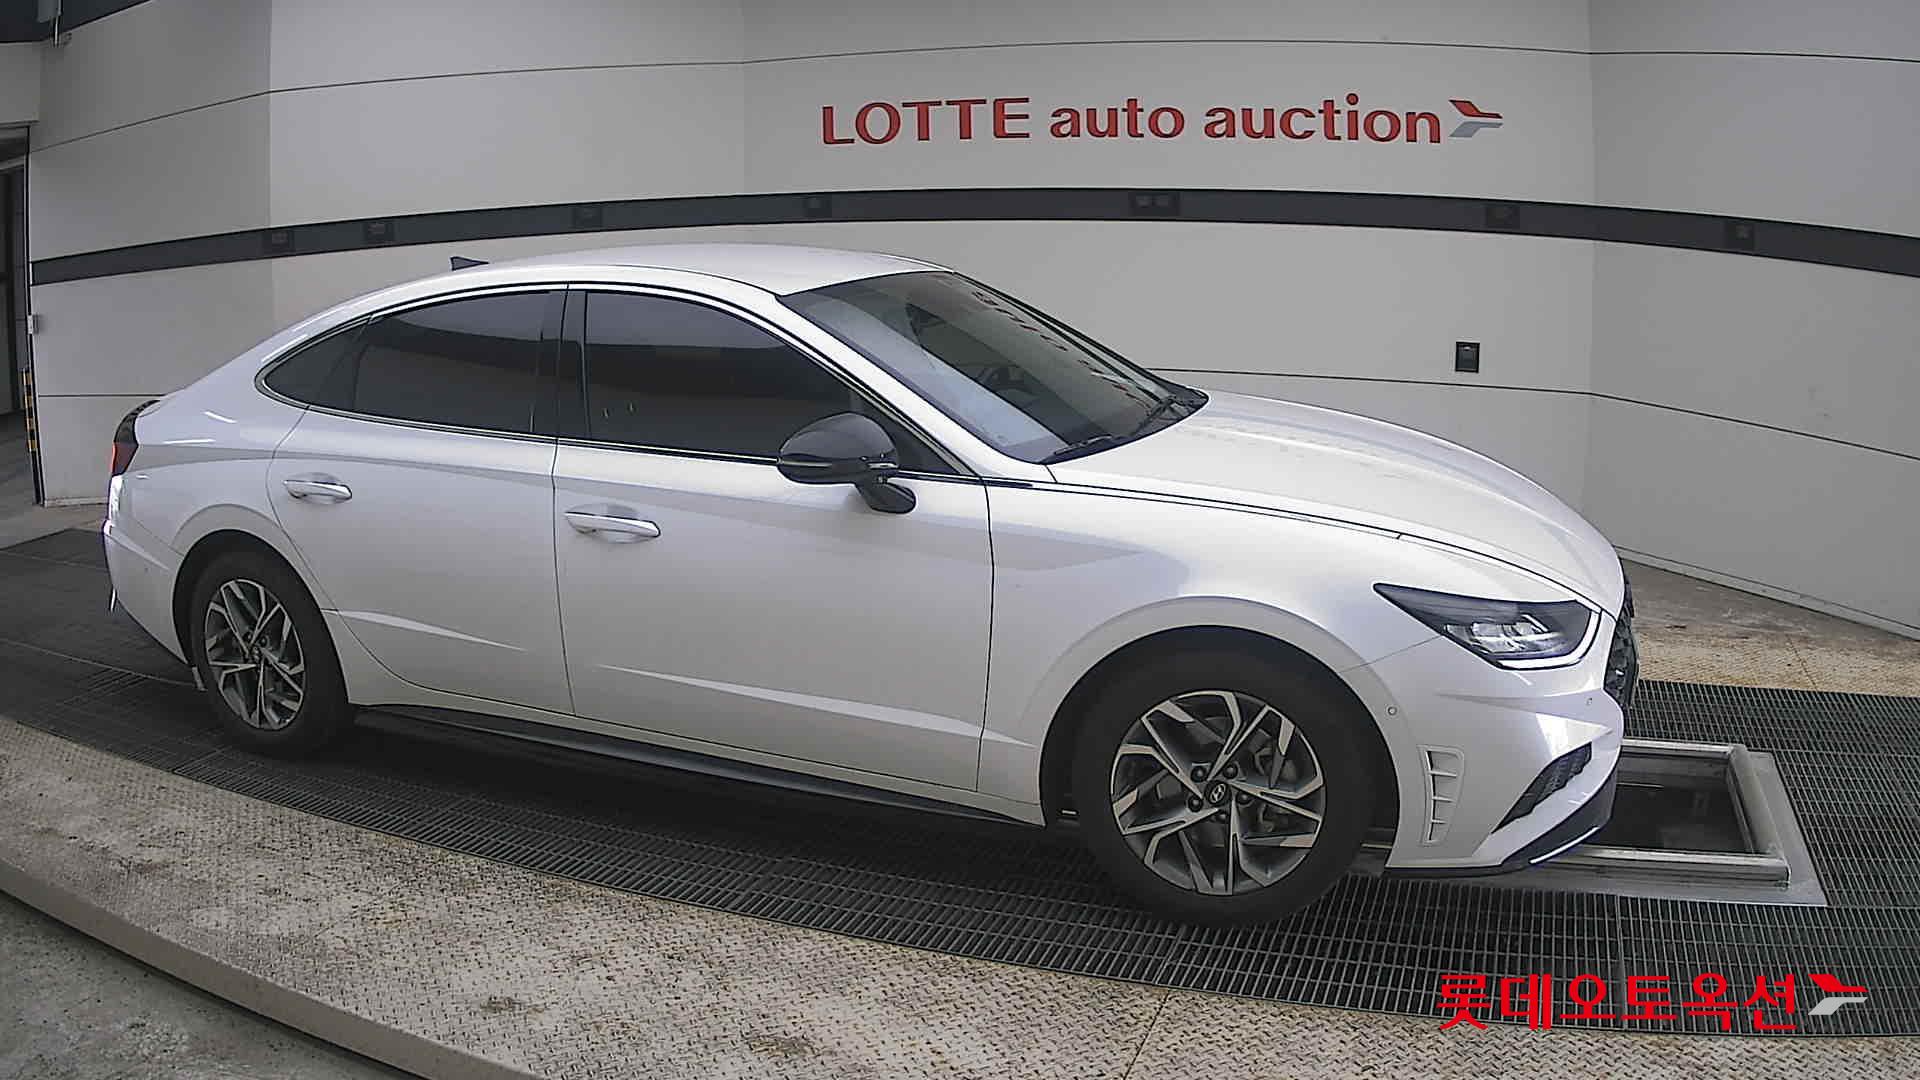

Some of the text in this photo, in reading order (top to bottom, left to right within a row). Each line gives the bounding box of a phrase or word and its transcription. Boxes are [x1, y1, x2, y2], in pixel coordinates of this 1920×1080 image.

[822, 92, 1441, 145] LOTTE auto auction
